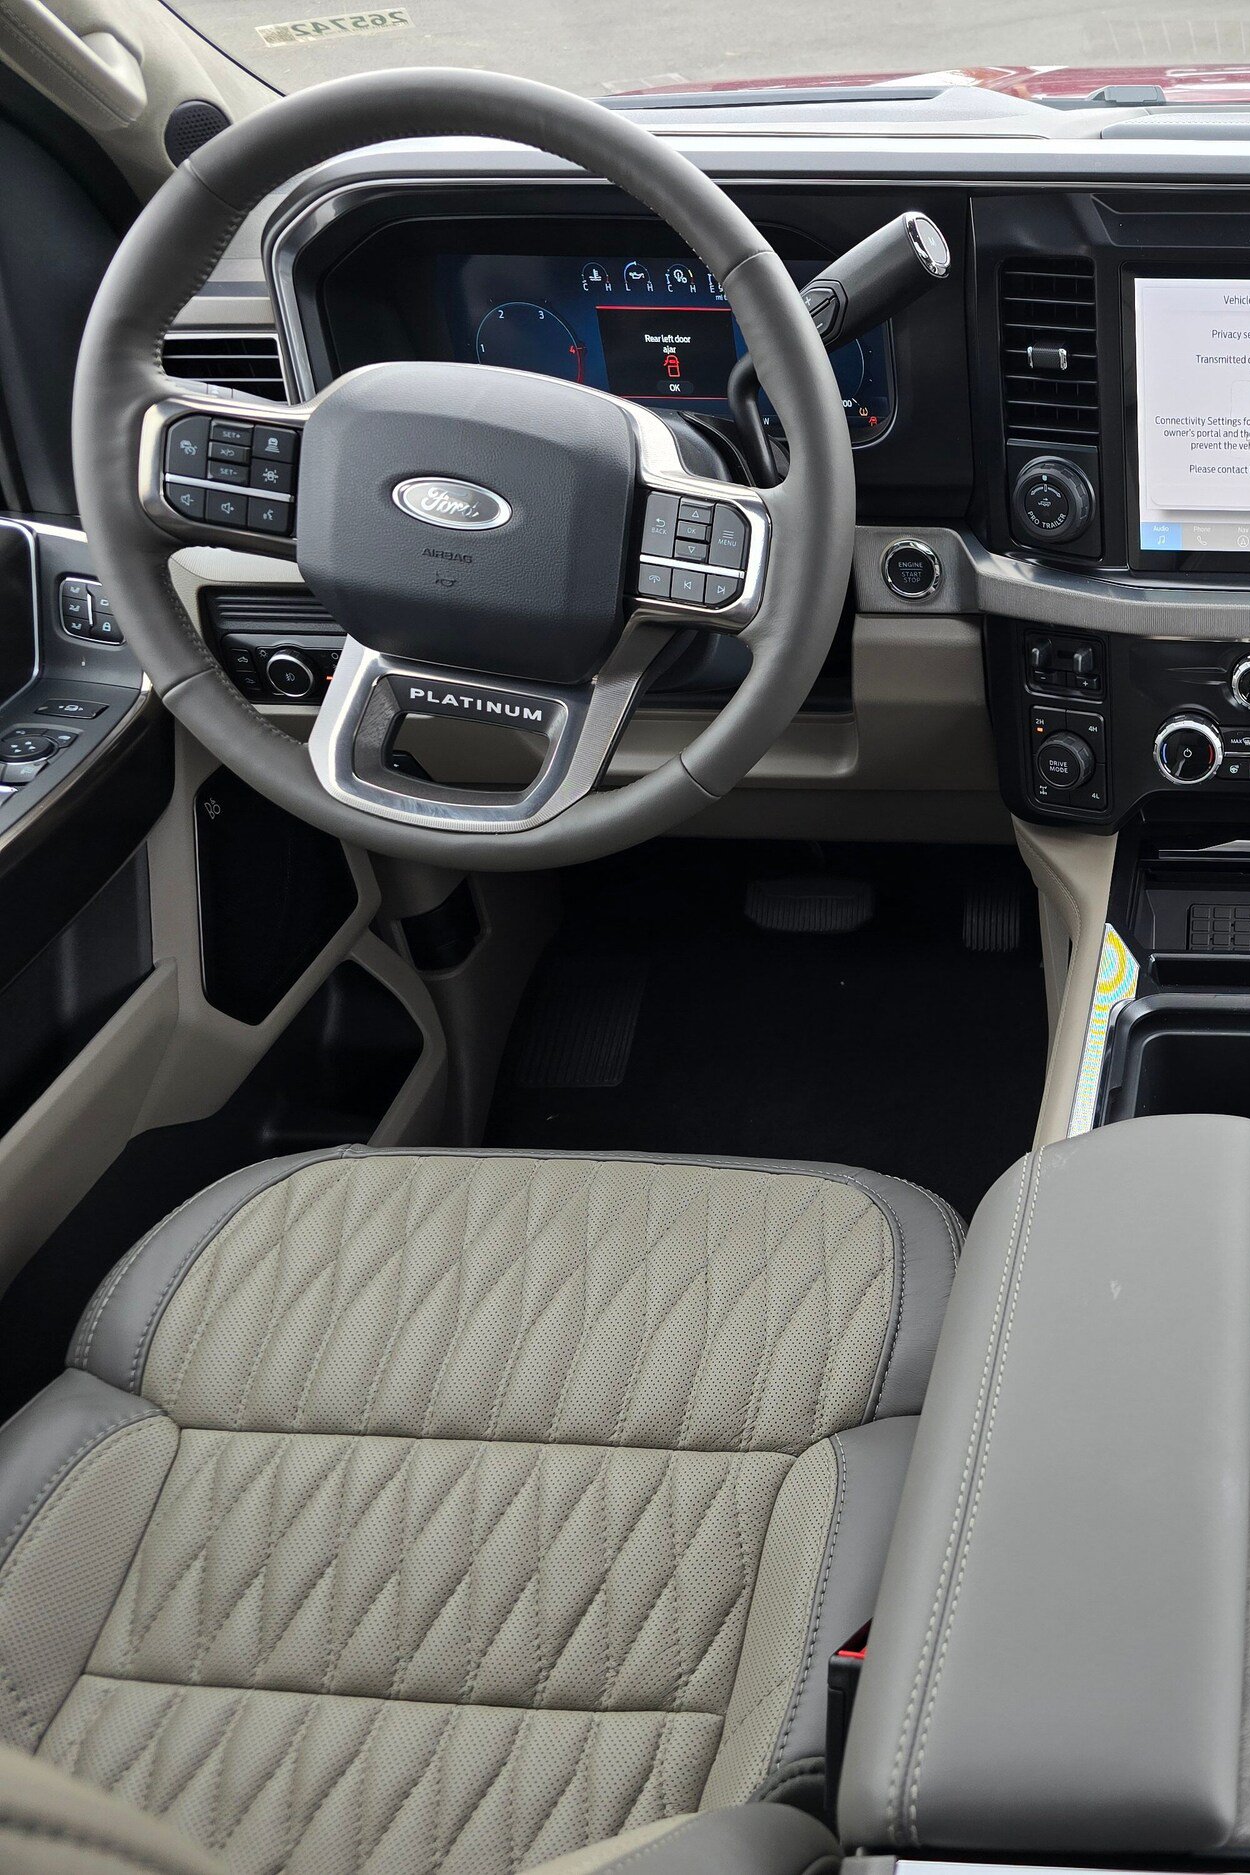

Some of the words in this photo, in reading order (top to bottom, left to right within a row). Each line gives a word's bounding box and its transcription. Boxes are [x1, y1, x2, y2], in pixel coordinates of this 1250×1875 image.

[605, 283, 612, 291] H
[646, 283, 653, 292] H
[690, 285, 696, 293] H
[498, 310, 504, 319] 2
[539, 310, 545, 319] 3
[644, 334, 661, 343] Rear
[662, 334, 674, 343] left
[675, 334, 691, 343] door
[1211, 330, 1242, 340] Privacy
[480, 344, 485, 353] 1
[569, 345, 576, 354] 4
[663, 345, 676, 354] ajar
[1196, 354, 1246, 364] Transmitted
[669, 383, 681, 392] OK
[1155, 416, 1206, 427] Connectivity
[1207, 416, 1241, 427] Settings
[1163, 428, 1195, 438] owner's
[1196, 429, 1221, 440] portal
[1223, 429, 1239, 438] and
[1190, 441, 1221, 451] prevent
[1223, 441, 1237, 450] the
[1189, 465, 1216, 475] Please
[1217, 465, 1248, 475] contact
[1026, 510, 1040, 526] PRO
[1042, 513, 1066, 529] TRAILER
[651, 527, 667, 535] BACK
[717, 538, 737, 547] MENU
[421, 547, 473, 564] AIRBAG
[409, 687, 543, 722] PLATINUM
[1088, 725, 1098, 733] 4H
[1049, 760, 1067, 768] DRIVE
[1050, 766, 1068, 774] MODE
[1091, 792, 1100, 800] 4L
